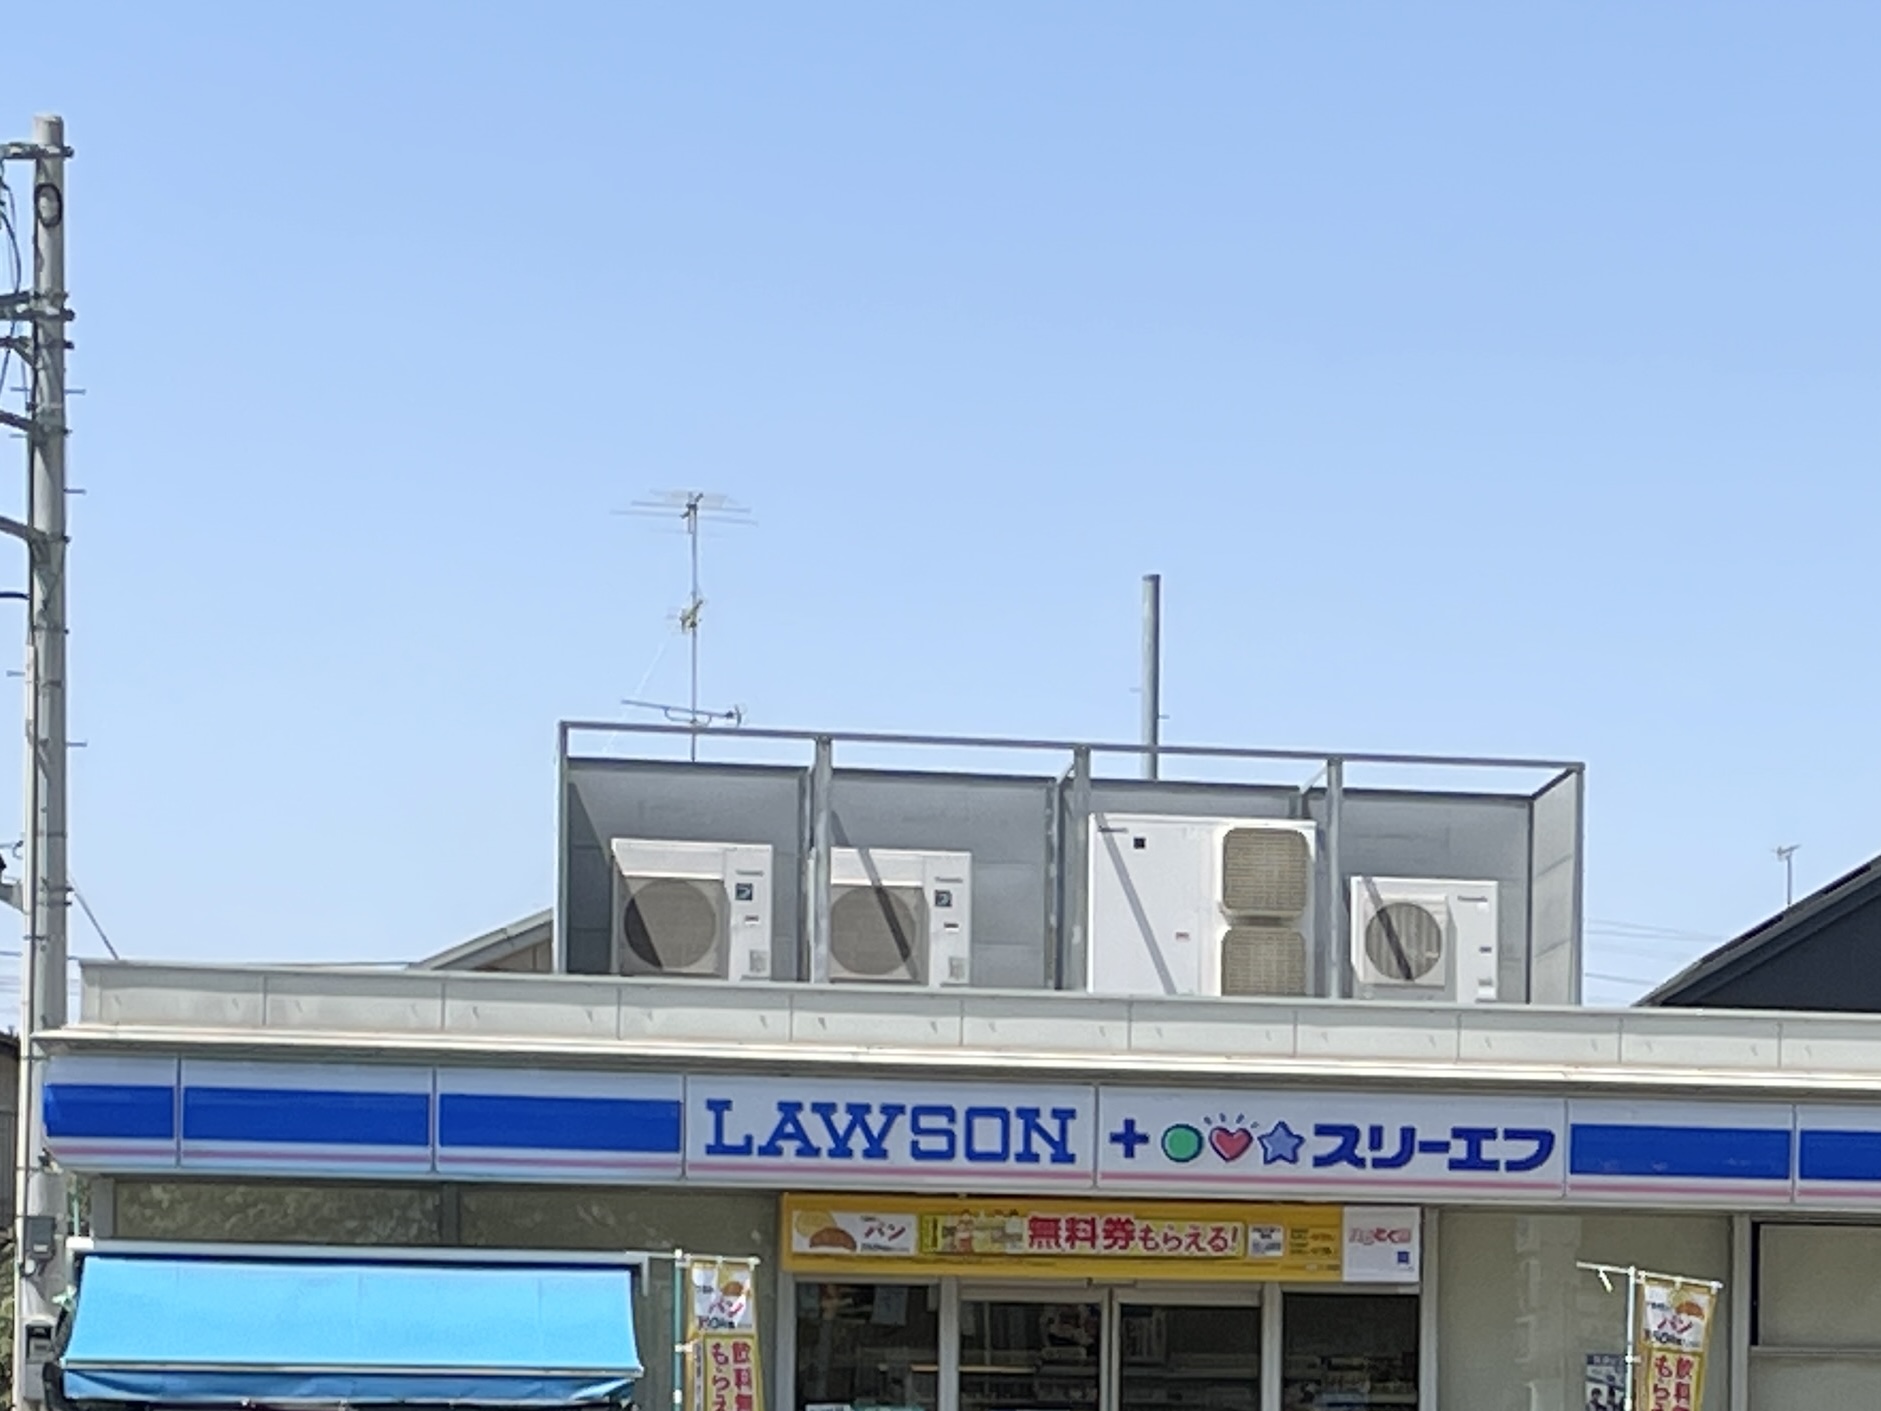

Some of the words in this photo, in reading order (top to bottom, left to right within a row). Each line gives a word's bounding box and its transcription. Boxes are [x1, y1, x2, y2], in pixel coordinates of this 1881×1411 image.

[705, 1098, 1077, 1164] LAWSON
[1312, 1123, 1555, 1172] スリーエフ
